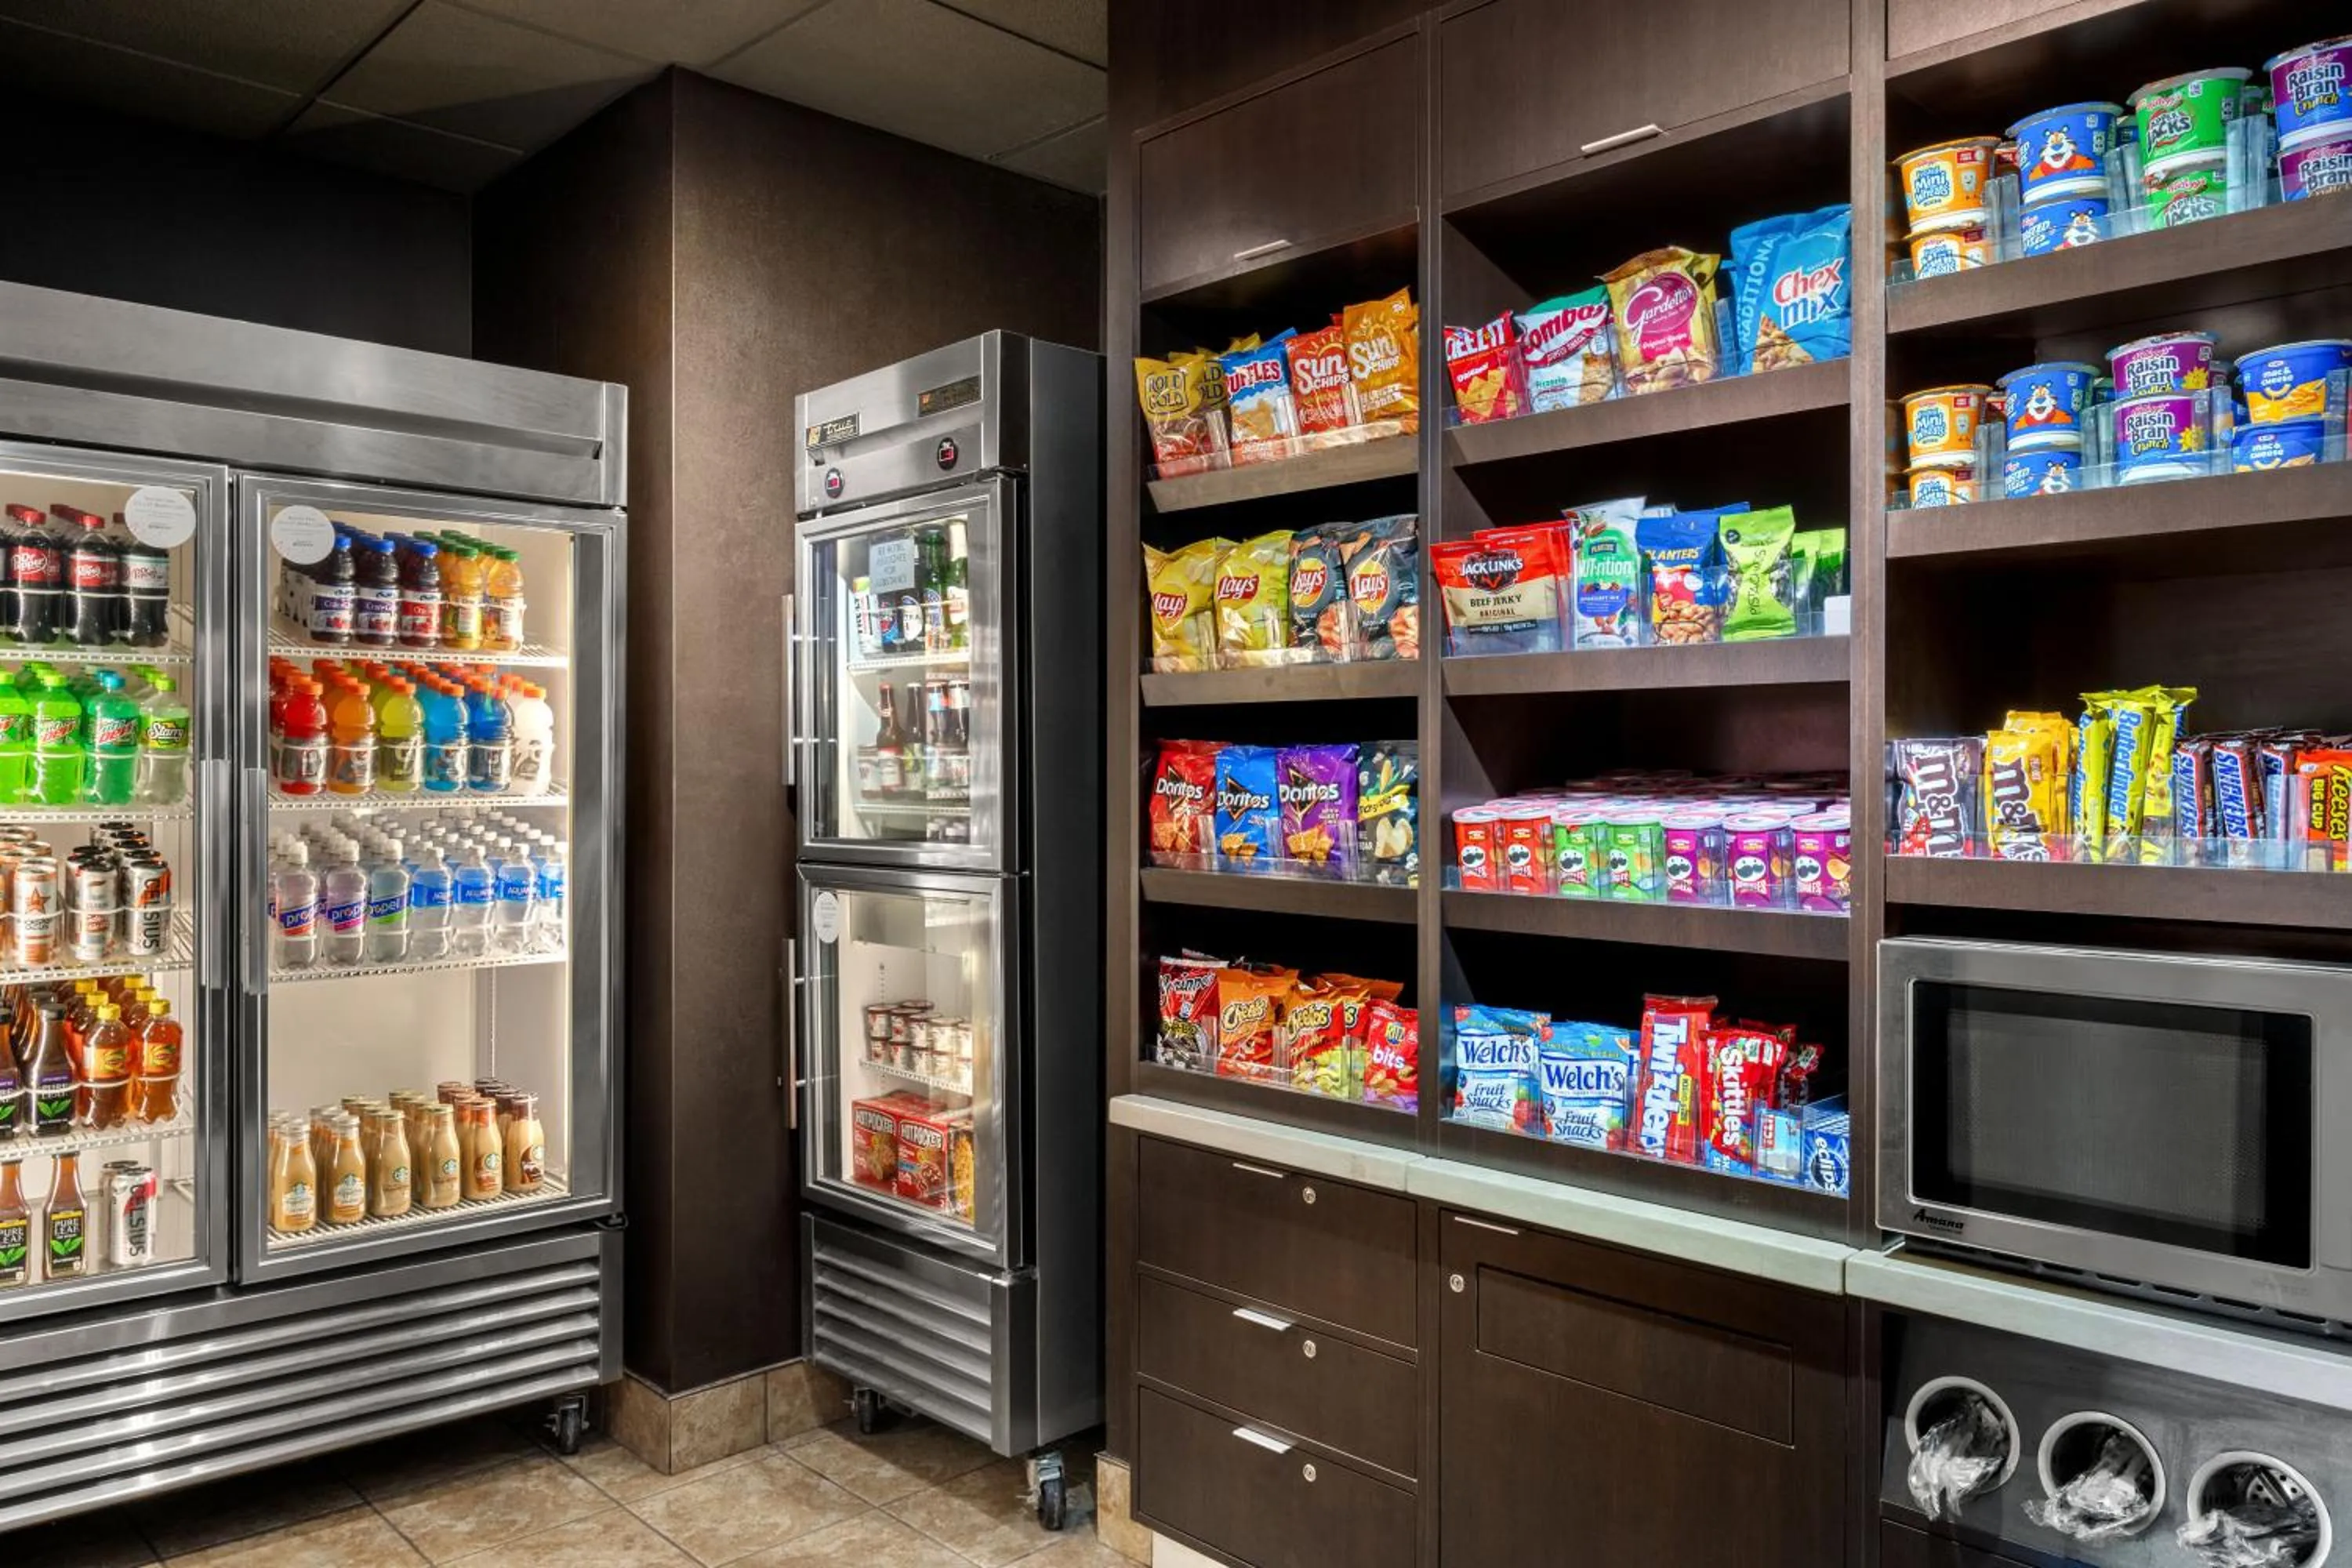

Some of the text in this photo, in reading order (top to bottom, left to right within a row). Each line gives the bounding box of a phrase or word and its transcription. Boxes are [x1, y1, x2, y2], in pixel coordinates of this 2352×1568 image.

[2288, 64, 2343, 90] Raisin
[2295, 79, 2336, 102] Bran
[2147, 116, 2191, 155] JACKS
[2307, 169, 2350, 191] Bran
[1773, 257, 1844, 306] Chex
[1737, 235, 1780, 352] TRADITIONA
[1348, 336, 1398, 379] Sun
[2126, 357, 2178, 378] Raisin
[1294, 354, 1347, 394] Sun
[1313, 372, 1349, 390] CHIPS
[2132, 371, 2172, 390] Bran
[2126, 412, 2174, 432] Raisin
[2132, 426, 2169, 444] Bran
[2132, 439, 2169, 455] Crunch
[1460, 563, 1488, 576] JACK
[1470, 594, 1523, 608] BEEF JERKY
[1479, 608, 1515, 618] ORIGINAL
[2110, 709, 2142, 822] Butterfinger
[1156, 778, 1203, 800] Doritos
[1216, 790, 1270, 809] Doritos
[1278, 783, 1340, 803] Doritos
[2215, 751, 2249, 839] SNICKERS
[2310, 778, 2326, 829] BIG CUP
[2328, 764, 2352, 842] Reese's
[1374, 1044, 1406, 1069] bits
[1461, 1039, 1532, 1065] Welch's
[1544, 1062, 1624, 1091] Welch's
[1467, 1093, 1511, 1109] Snacks
[1475, 1083, 1505, 1097] Fruit
[1719, 1044, 1748, 1148] Skittles
[1565, 1111, 1597, 1126] Fruit
[1555, 1123, 1602, 1138] Snacks
[1813, 1136, 1838, 1193] eclips
[54, 1218, 79, 1229] PURE
[1913, 1208, 1965, 1230] Amana
